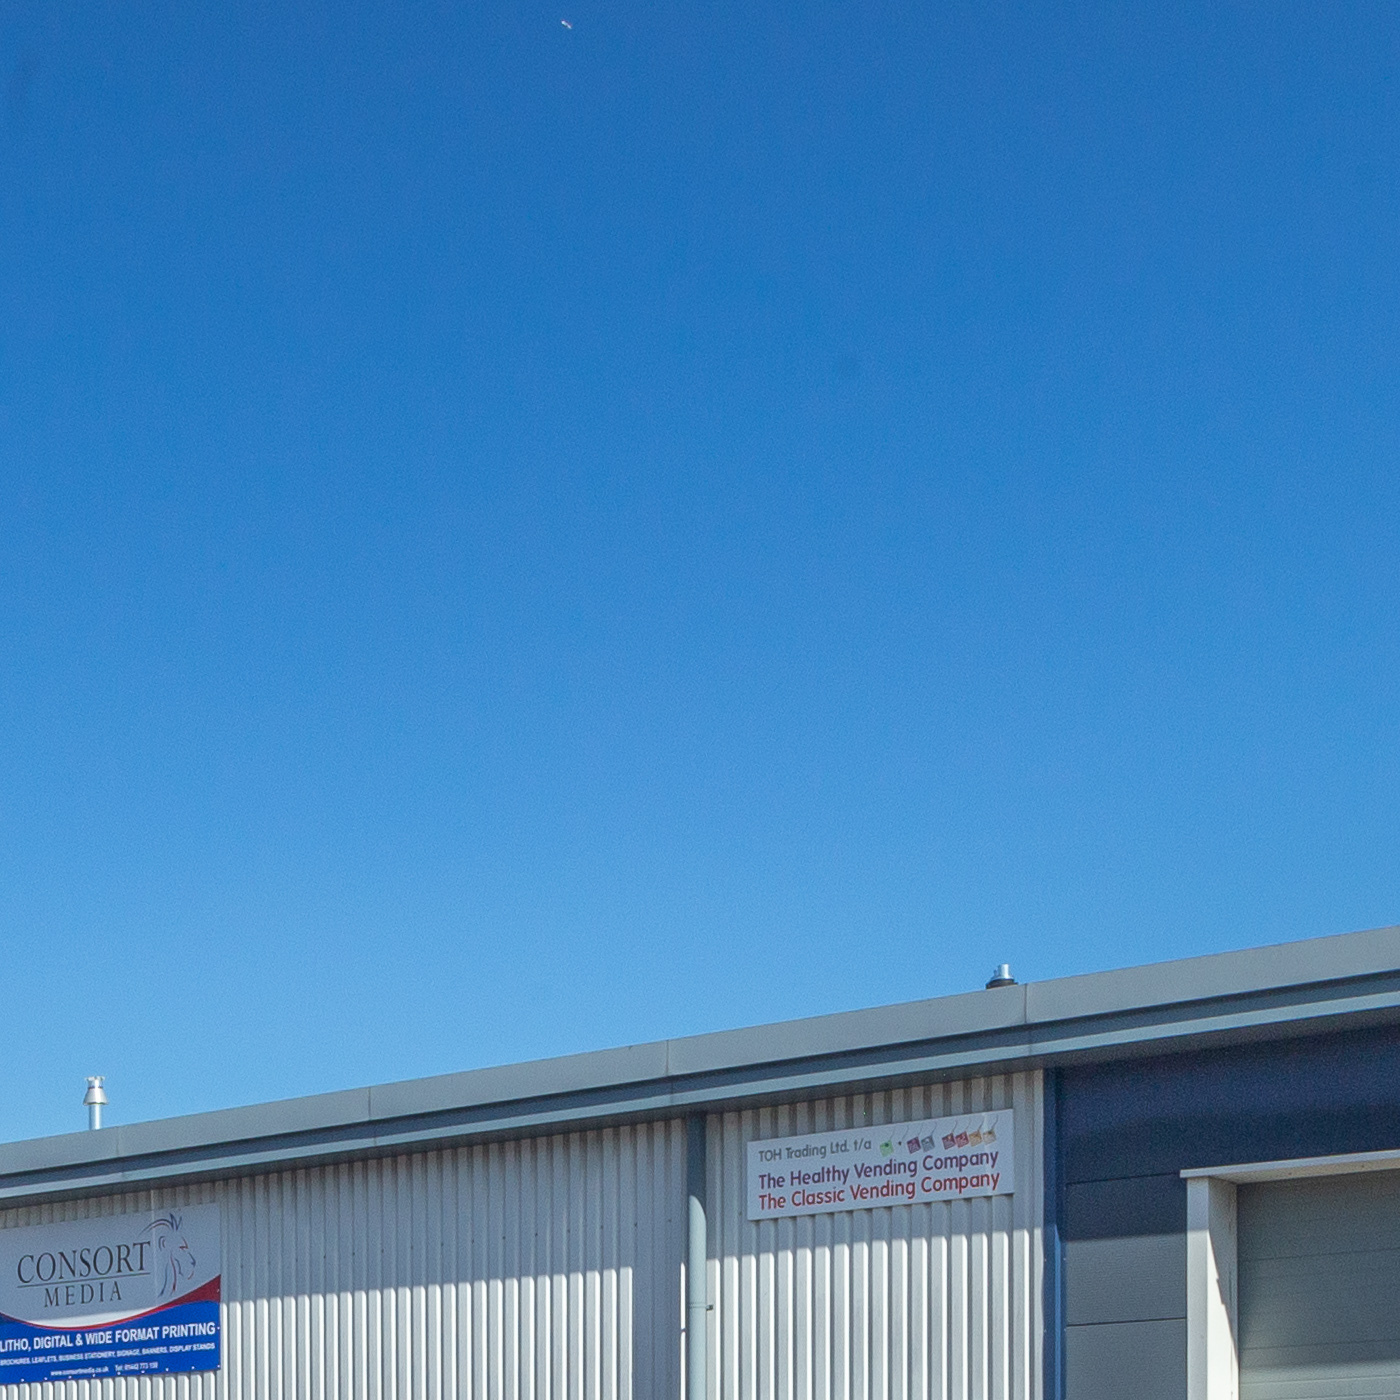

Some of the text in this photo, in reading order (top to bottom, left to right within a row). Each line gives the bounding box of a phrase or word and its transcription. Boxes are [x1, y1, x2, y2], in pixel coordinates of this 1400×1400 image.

[758, 1138, 872, 1162] TOH Trading Ltd. t/a
[759, 1151, 999, 1190] The Healthy Vending Company
[759, 1172, 1000, 1210] The Classic Vending Company
[17, 1240, 150, 1283] CONSORT
[44, 1281, 122, 1308] MEDIA
[0, 1322, 215, 1352] LITHO, DIGITAL & WIDE FORMAT PRINTING
